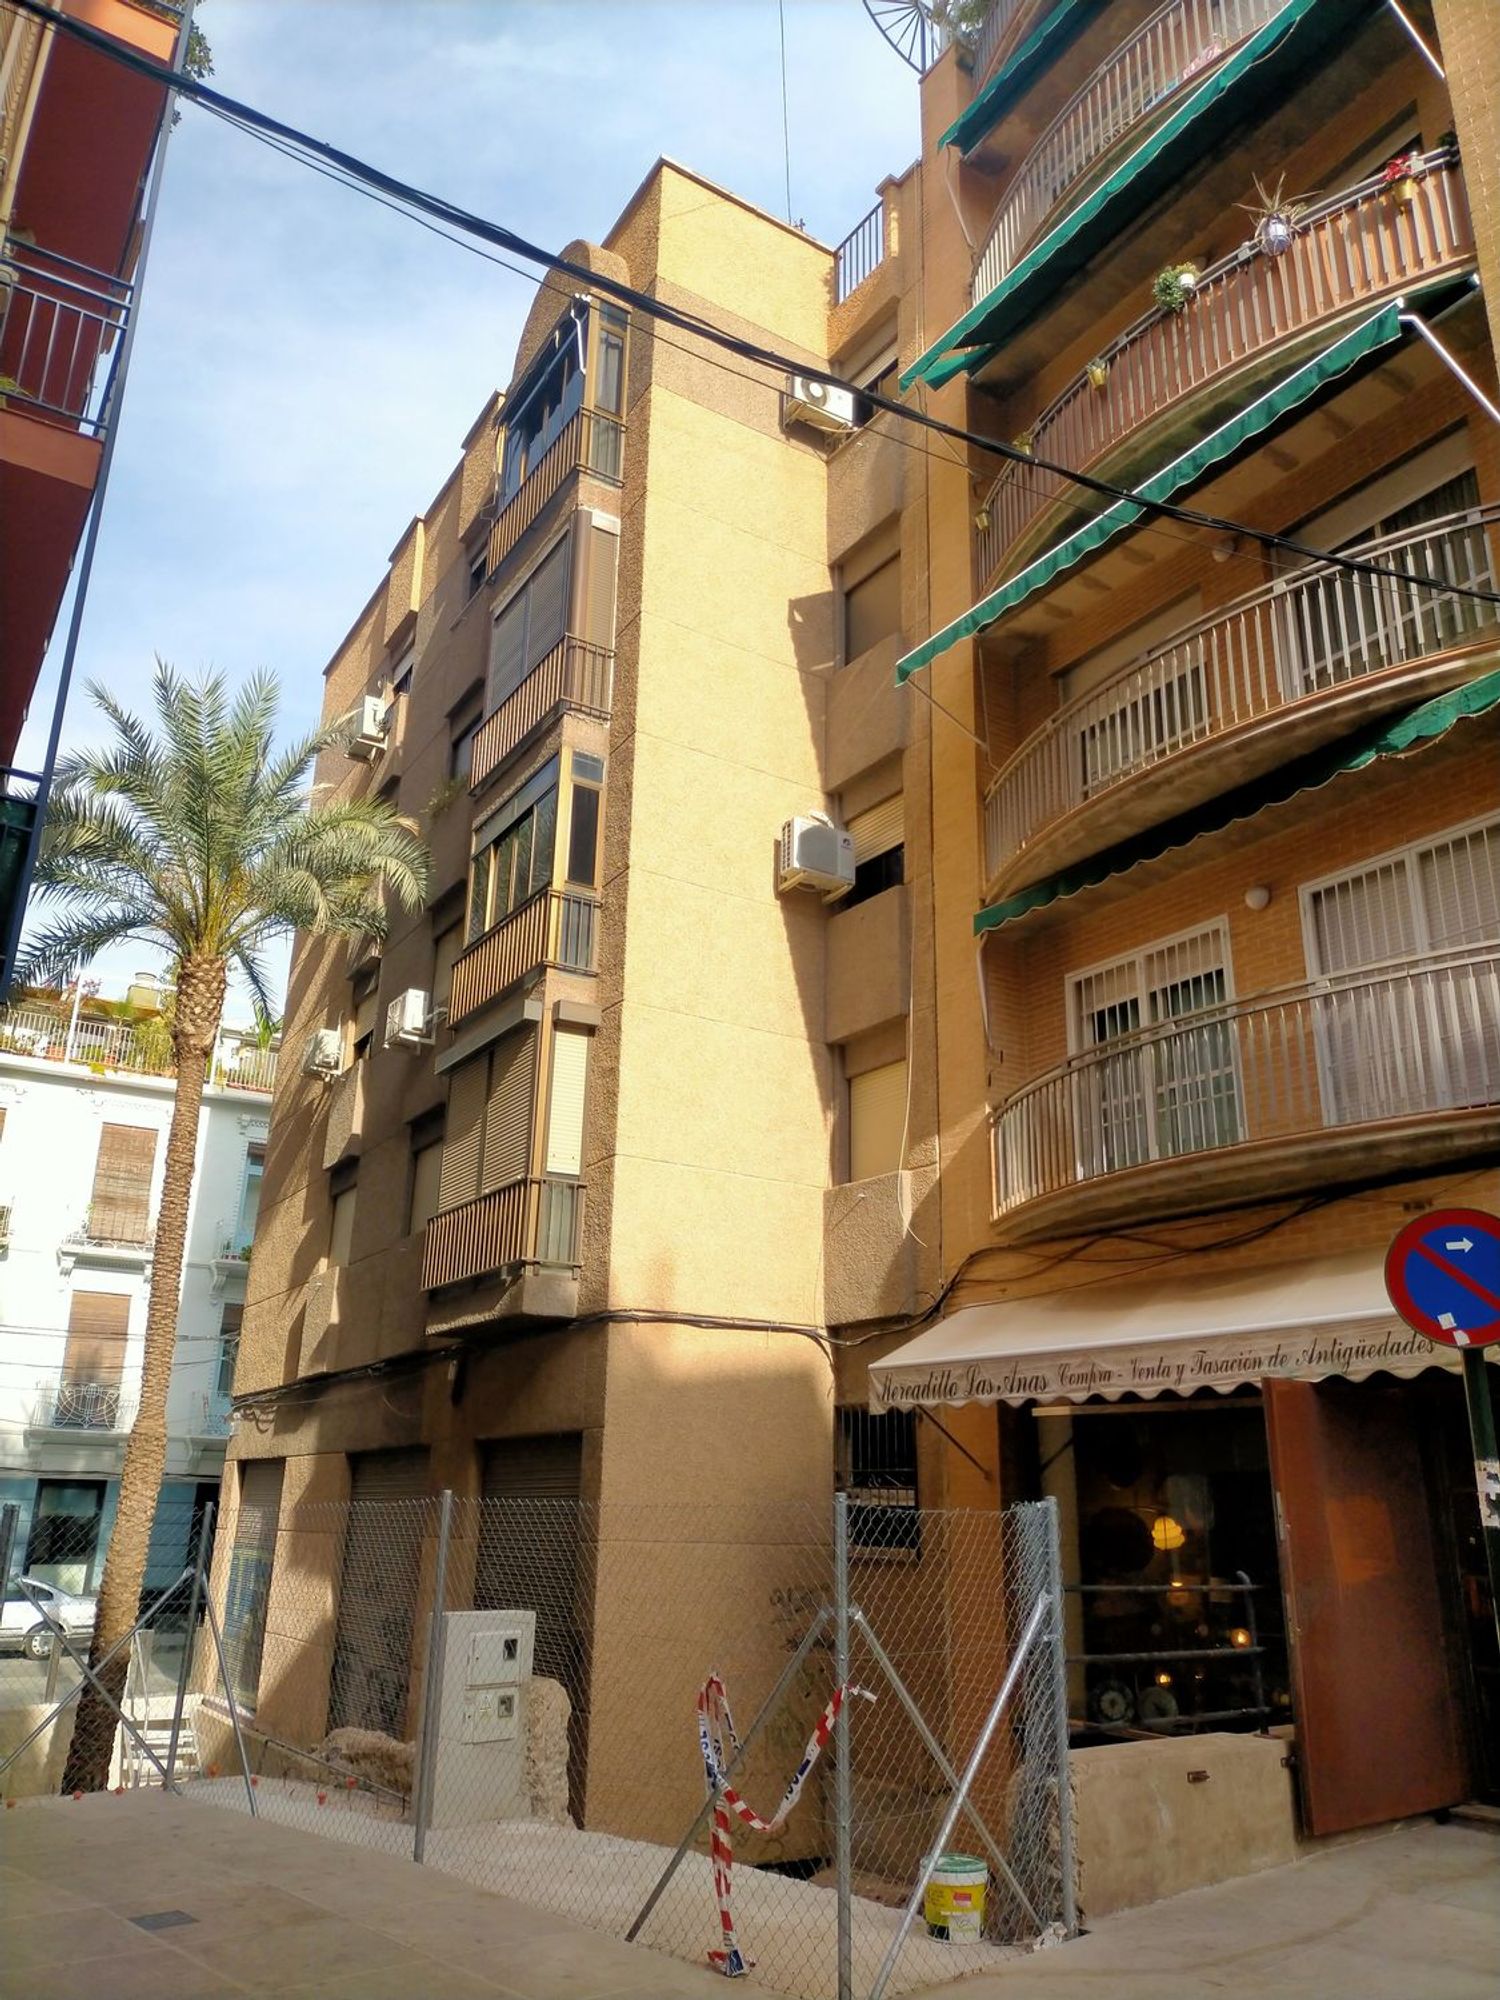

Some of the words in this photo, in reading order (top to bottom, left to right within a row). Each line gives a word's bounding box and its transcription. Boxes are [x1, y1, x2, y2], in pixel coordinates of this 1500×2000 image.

[880, 1369, 958, 1402] Mercadillo
[964, 1362, 993, 1398] Las
[998, 1360, 1047, 1394] Anas
[1058, 1362, 1113, 1393] Compra
[1130, 1356, 1171, 1381] Venta
[1175, 1362, 1186, 1386] y
[1190, 1350, 1262, 1375] Tasación
[1268, 1343, 1288, 1368] de
[1295, 1330, 1434, 1374] Antigüedades
